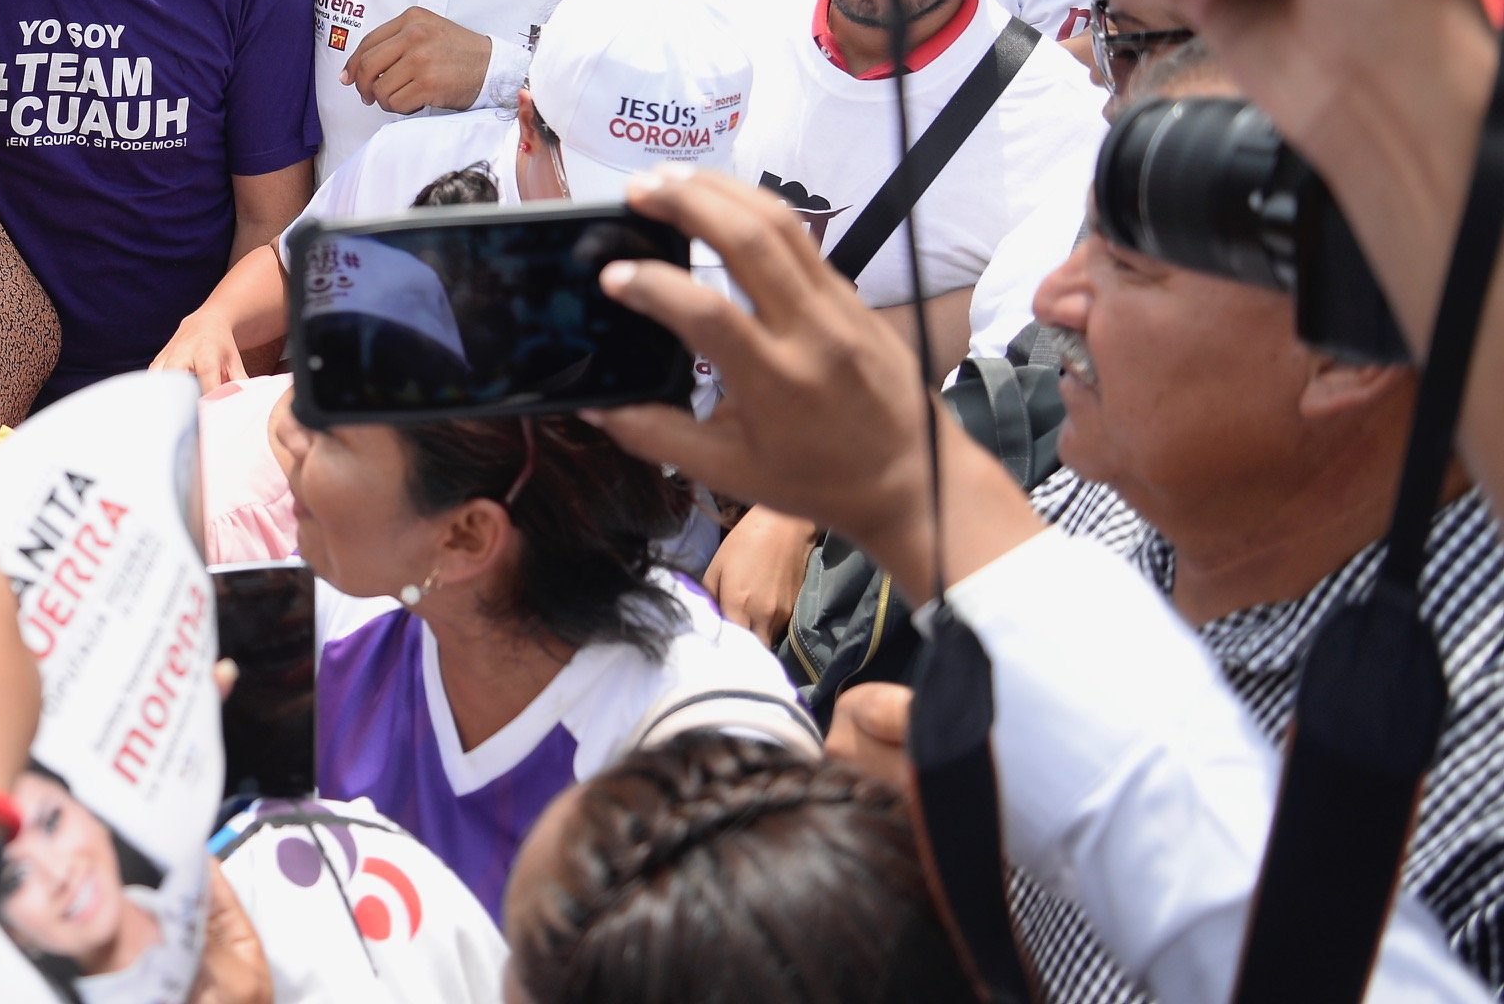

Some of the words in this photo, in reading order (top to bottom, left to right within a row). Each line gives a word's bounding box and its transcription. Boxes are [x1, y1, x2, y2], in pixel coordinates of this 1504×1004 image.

[19, 19, 62, 47] YO
[66, 22, 126, 49] SOY
[331, 33, 346, 49] PT
[15, 52, 153, 98] TEAM
[10, 95, 190, 140] CUAUH
[615, 95, 697, 128] JESÚS
[6, 137, 29, 147] ¡EN
[33, 136, 91, 148] EQUIPO,
[110, 137, 188, 152] PODEMOS!
[609, 117, 711, 148] CORONA
[644, 146, 683, 156] PRESIDENTE
[111, 585, 212, 786] morena
